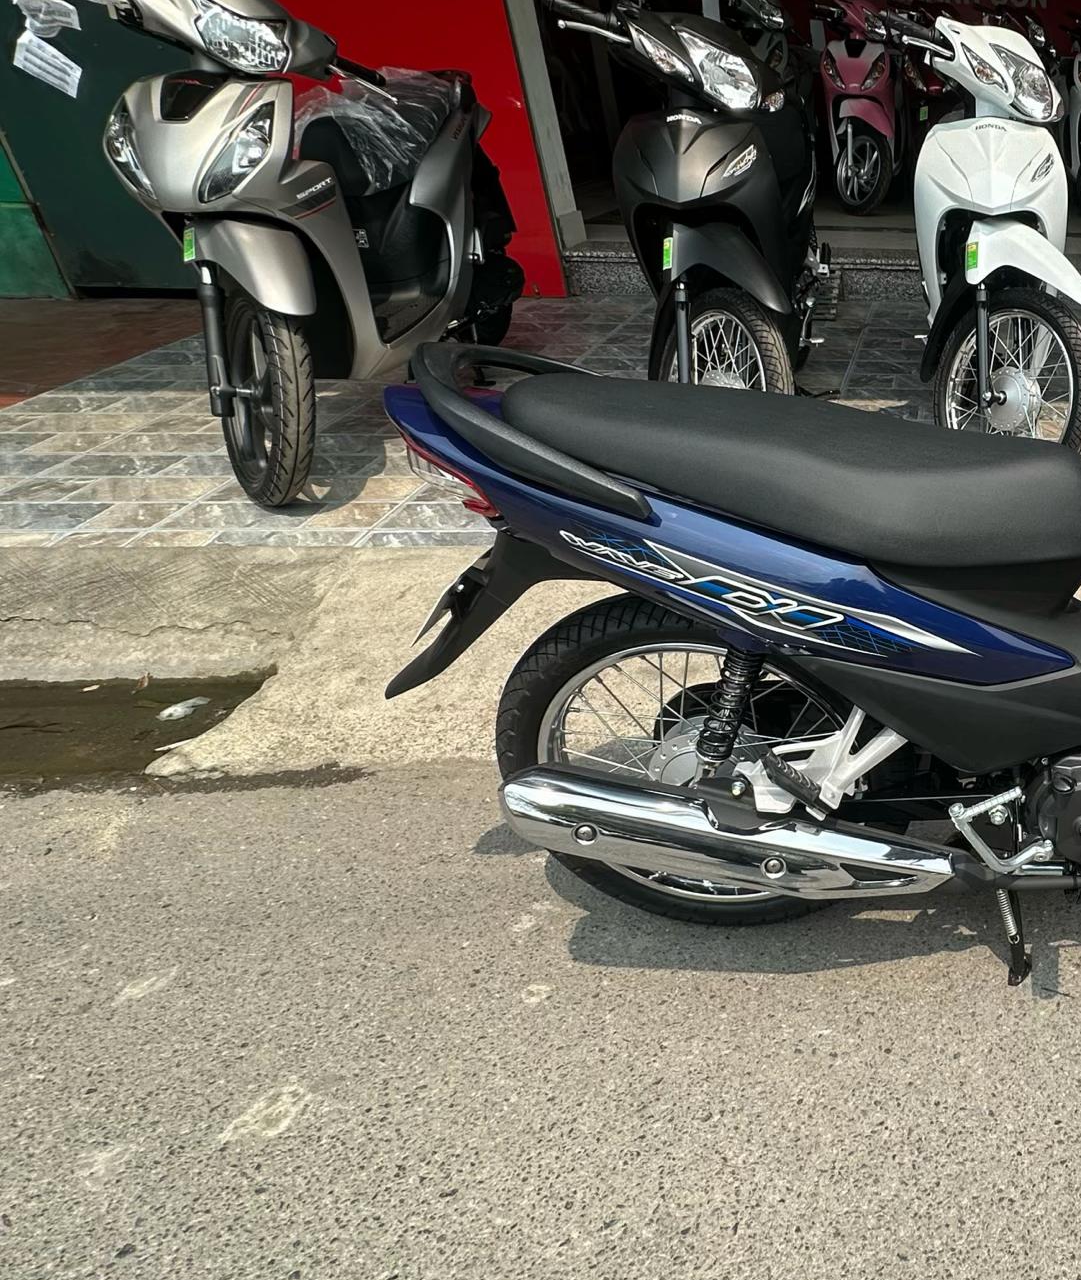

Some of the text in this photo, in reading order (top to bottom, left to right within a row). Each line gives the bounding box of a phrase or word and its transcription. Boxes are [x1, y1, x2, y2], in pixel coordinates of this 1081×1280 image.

[666, 114, 702, 125] HONDA
[975, 123, 1007, 132] HONDA
[295, 177, 333, 200] SPORT
